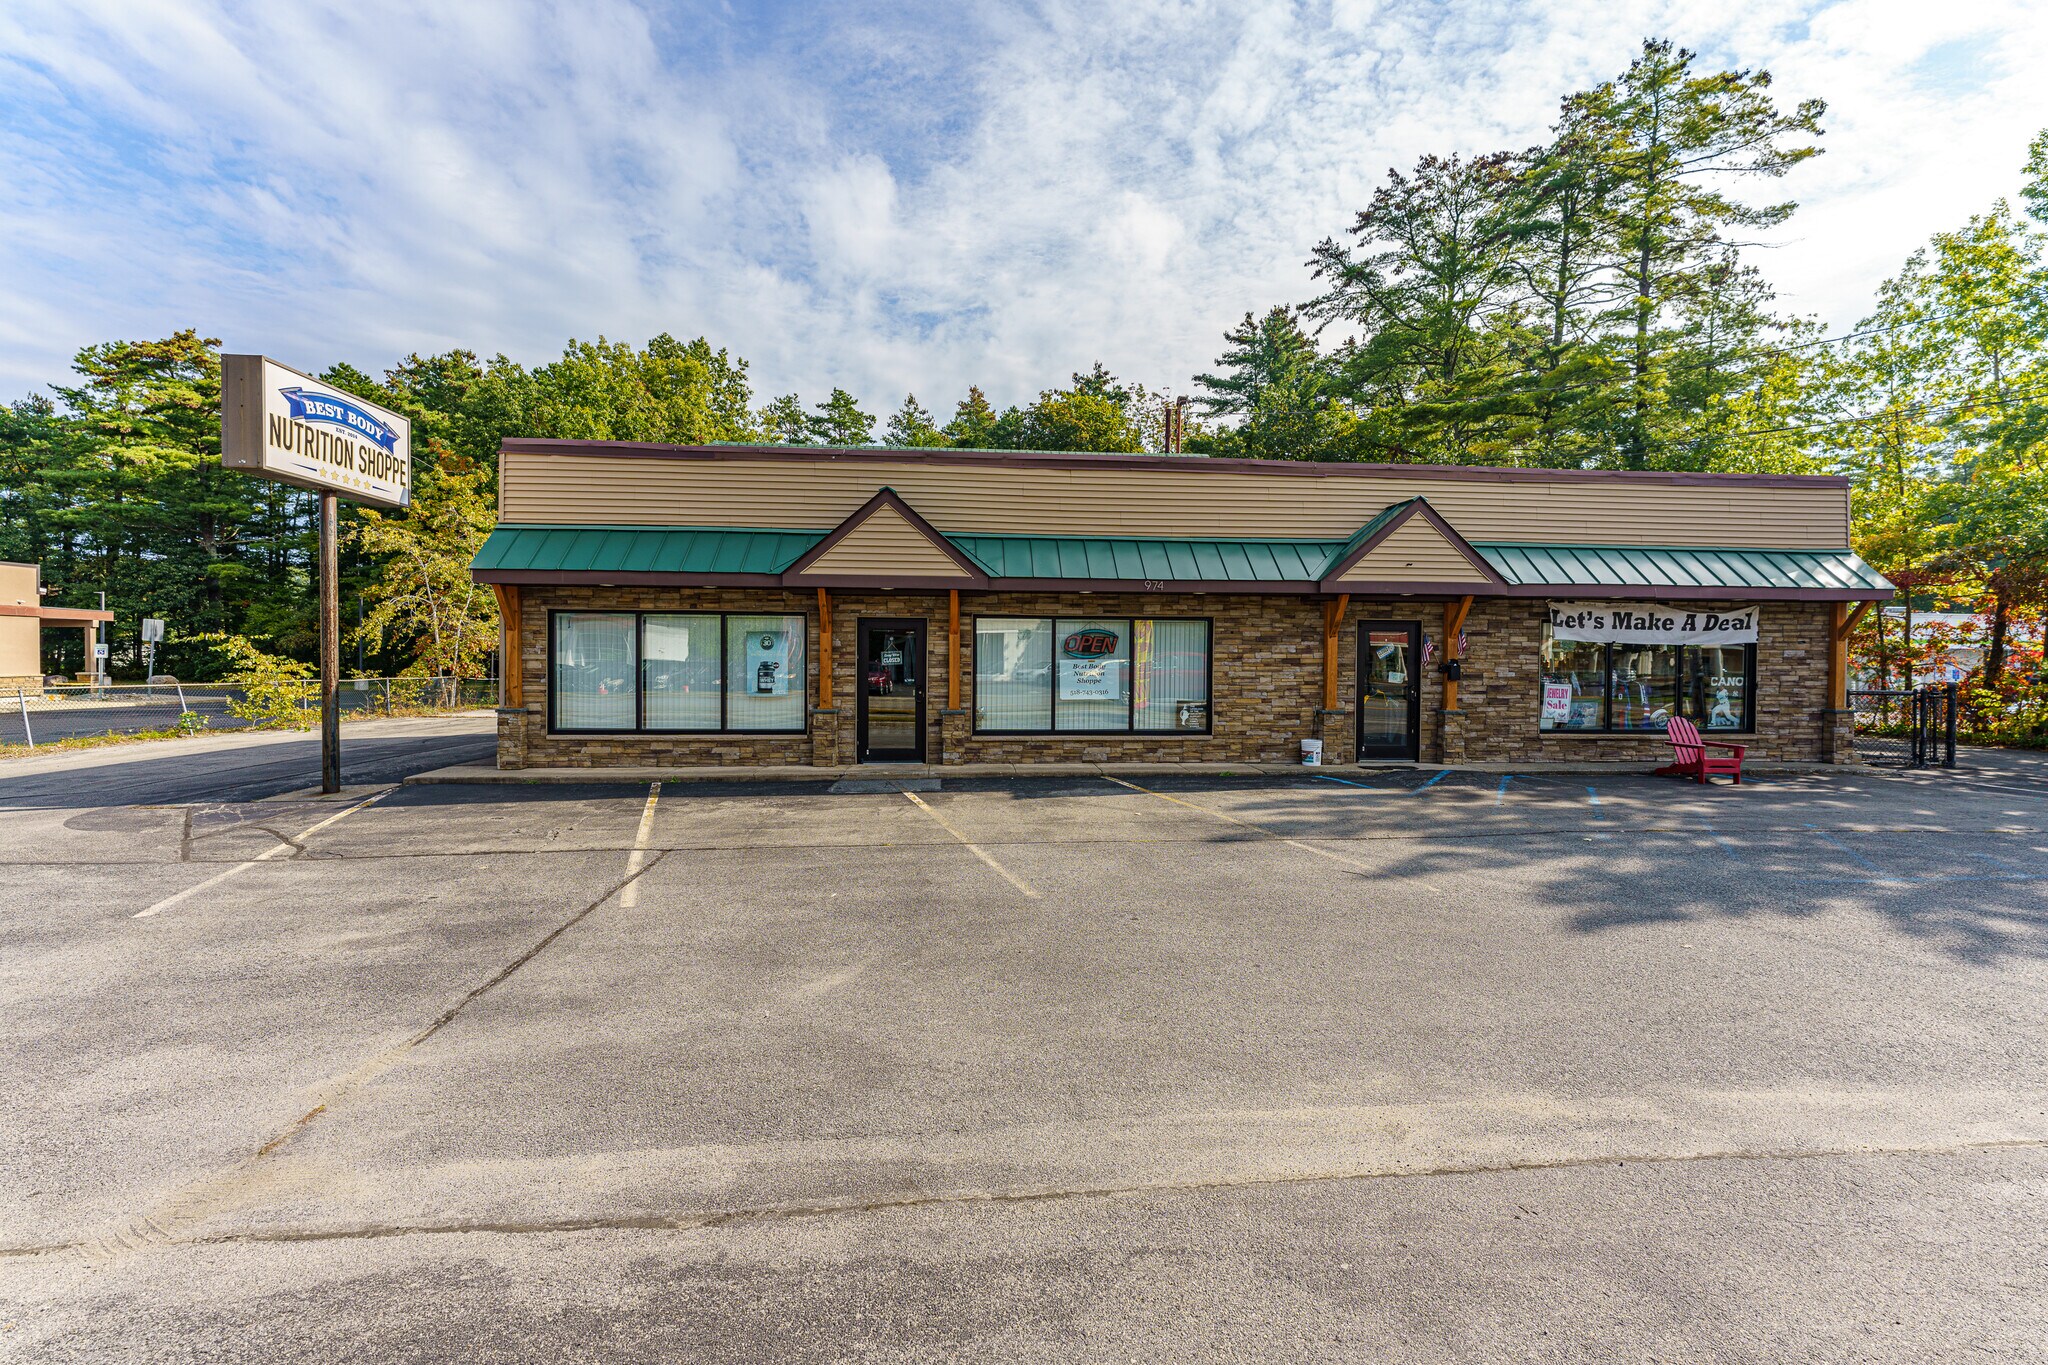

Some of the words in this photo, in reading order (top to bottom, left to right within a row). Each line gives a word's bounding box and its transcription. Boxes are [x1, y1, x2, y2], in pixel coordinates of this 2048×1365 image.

[304, 400, 343, 420] BEST
[347, 410, 384, 441] BODY
[335, 427, 347, 435] EST.
[269, 412, 354, 470] NUTRITION
[359, 444, 406, 487] SHOPPE
[1144, 580, 1164, 591] 974
[1551, 609, 1605, 630] Let's
[1611, 611, 1675, 631] Make
[1681, 613, 1697, 632] A
[1703, 612, 1753, 631] Deal
[1064, 634, 1118, 654] OPEN
[1076, 677, 1102, 685] Shoppe
[1710, 676, 1744, 687] CANO
[1546, 687, 1569, 700] JEWELRY
[1546, 699, 1567, 710] Sale
